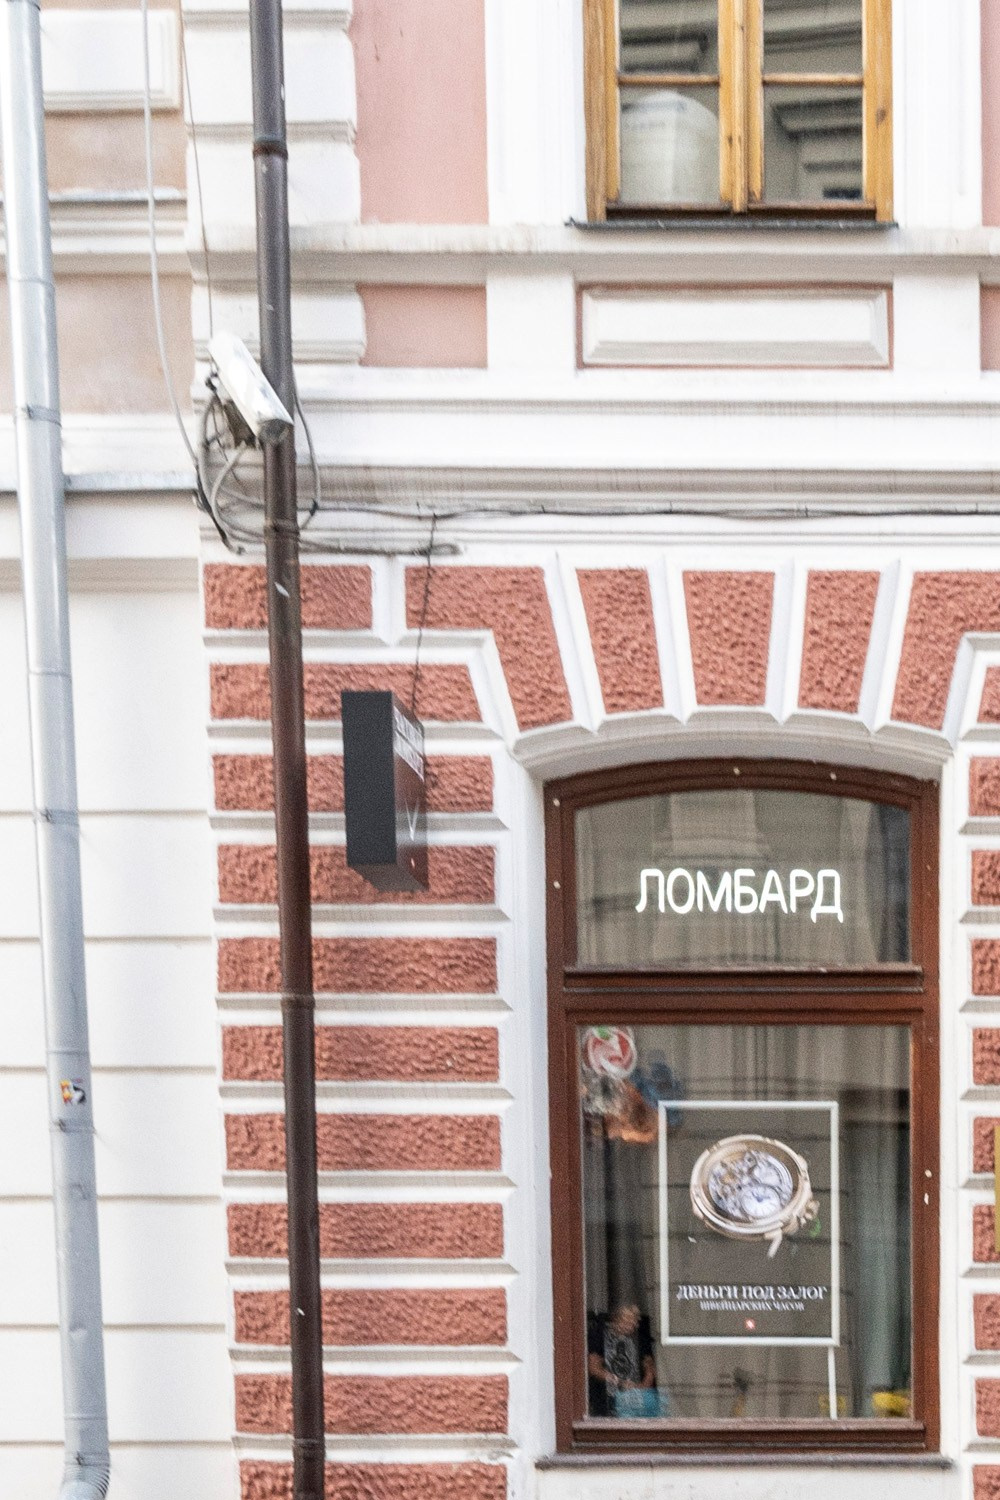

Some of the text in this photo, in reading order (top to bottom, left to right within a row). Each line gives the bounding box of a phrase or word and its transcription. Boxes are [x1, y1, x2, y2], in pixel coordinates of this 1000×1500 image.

[635, 868, 844, 924] ЛОМБАРД
[676, 1285, 828, 1300] ДЕНЬГИ ПОД ЗАЛОГ
